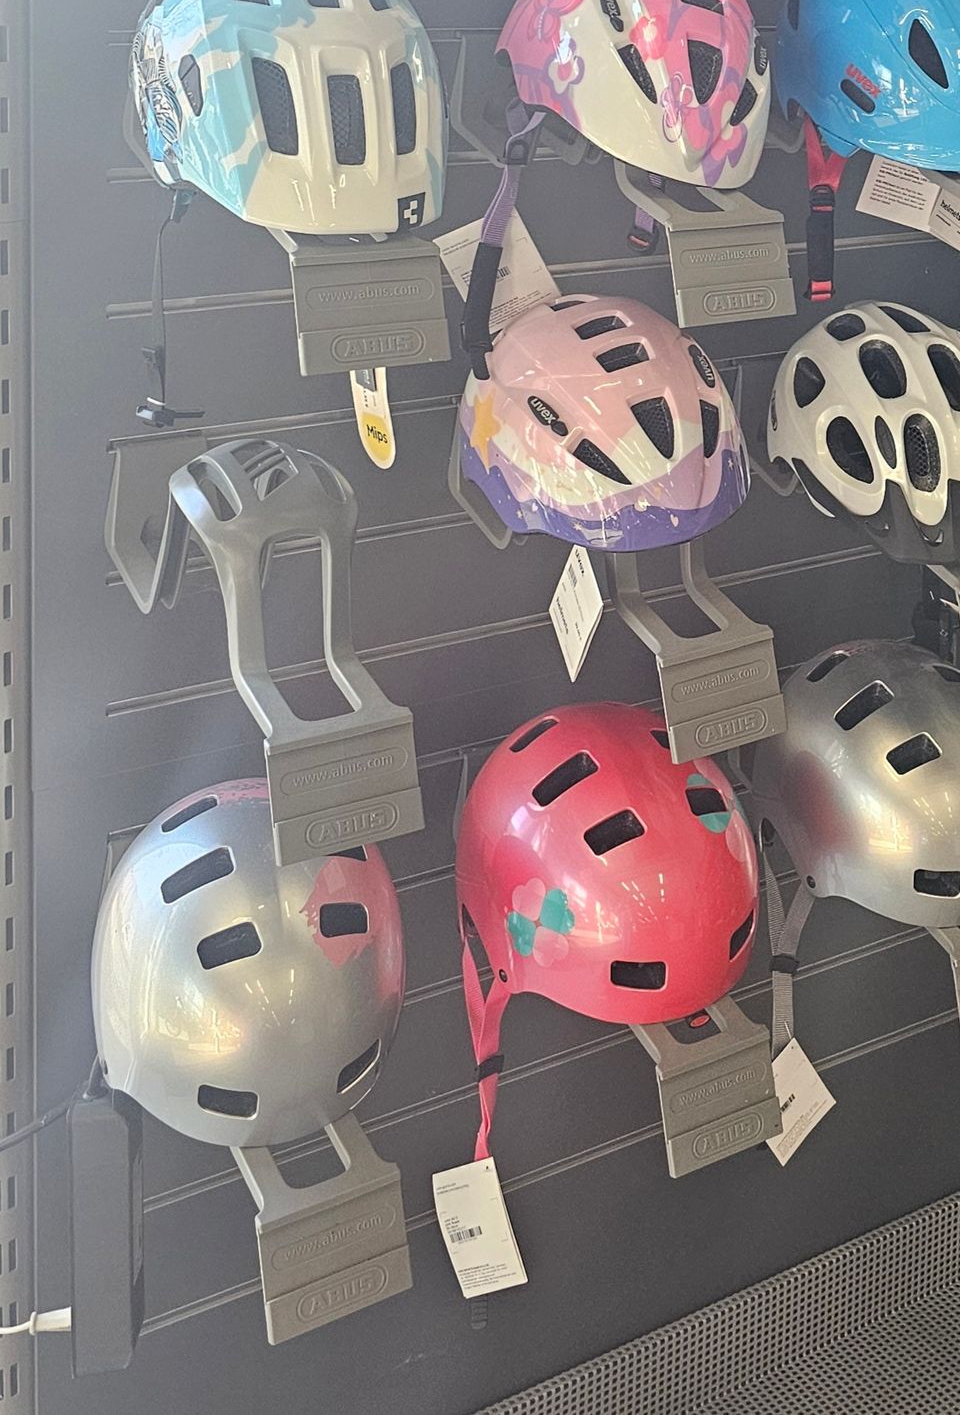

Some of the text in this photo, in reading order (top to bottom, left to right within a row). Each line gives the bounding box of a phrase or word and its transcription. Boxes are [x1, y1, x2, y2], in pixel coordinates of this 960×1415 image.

[759, 47, 768, 69] uvex
[846, 63, 881, 98] uvex
[689, 247, 769, 263] www.abus.com
[318, 284, 420, 303] www.abus.com
[713, 292, 766, 311] ABUS
[345, 335, 412, 356] ABUS
[699, 354, 716, 386] uvex
[530, 397, 556, 425] uvex
[366, 424, 388, 444] Mips
[680, 664, 760, 697] www.abus.com
[705, 711, 755, 741] ABUS
[291, 752, 394, 786] www.abus.com
[317, 810, 387, 842] ABUS
[679, 1067, 756, 1105] www.abus.com
[701, 1115, 756, 1151] ABUS
[282, 1212, 384, 1262] www.abus.com
[308, 1269, 378, 1315] ABUS
